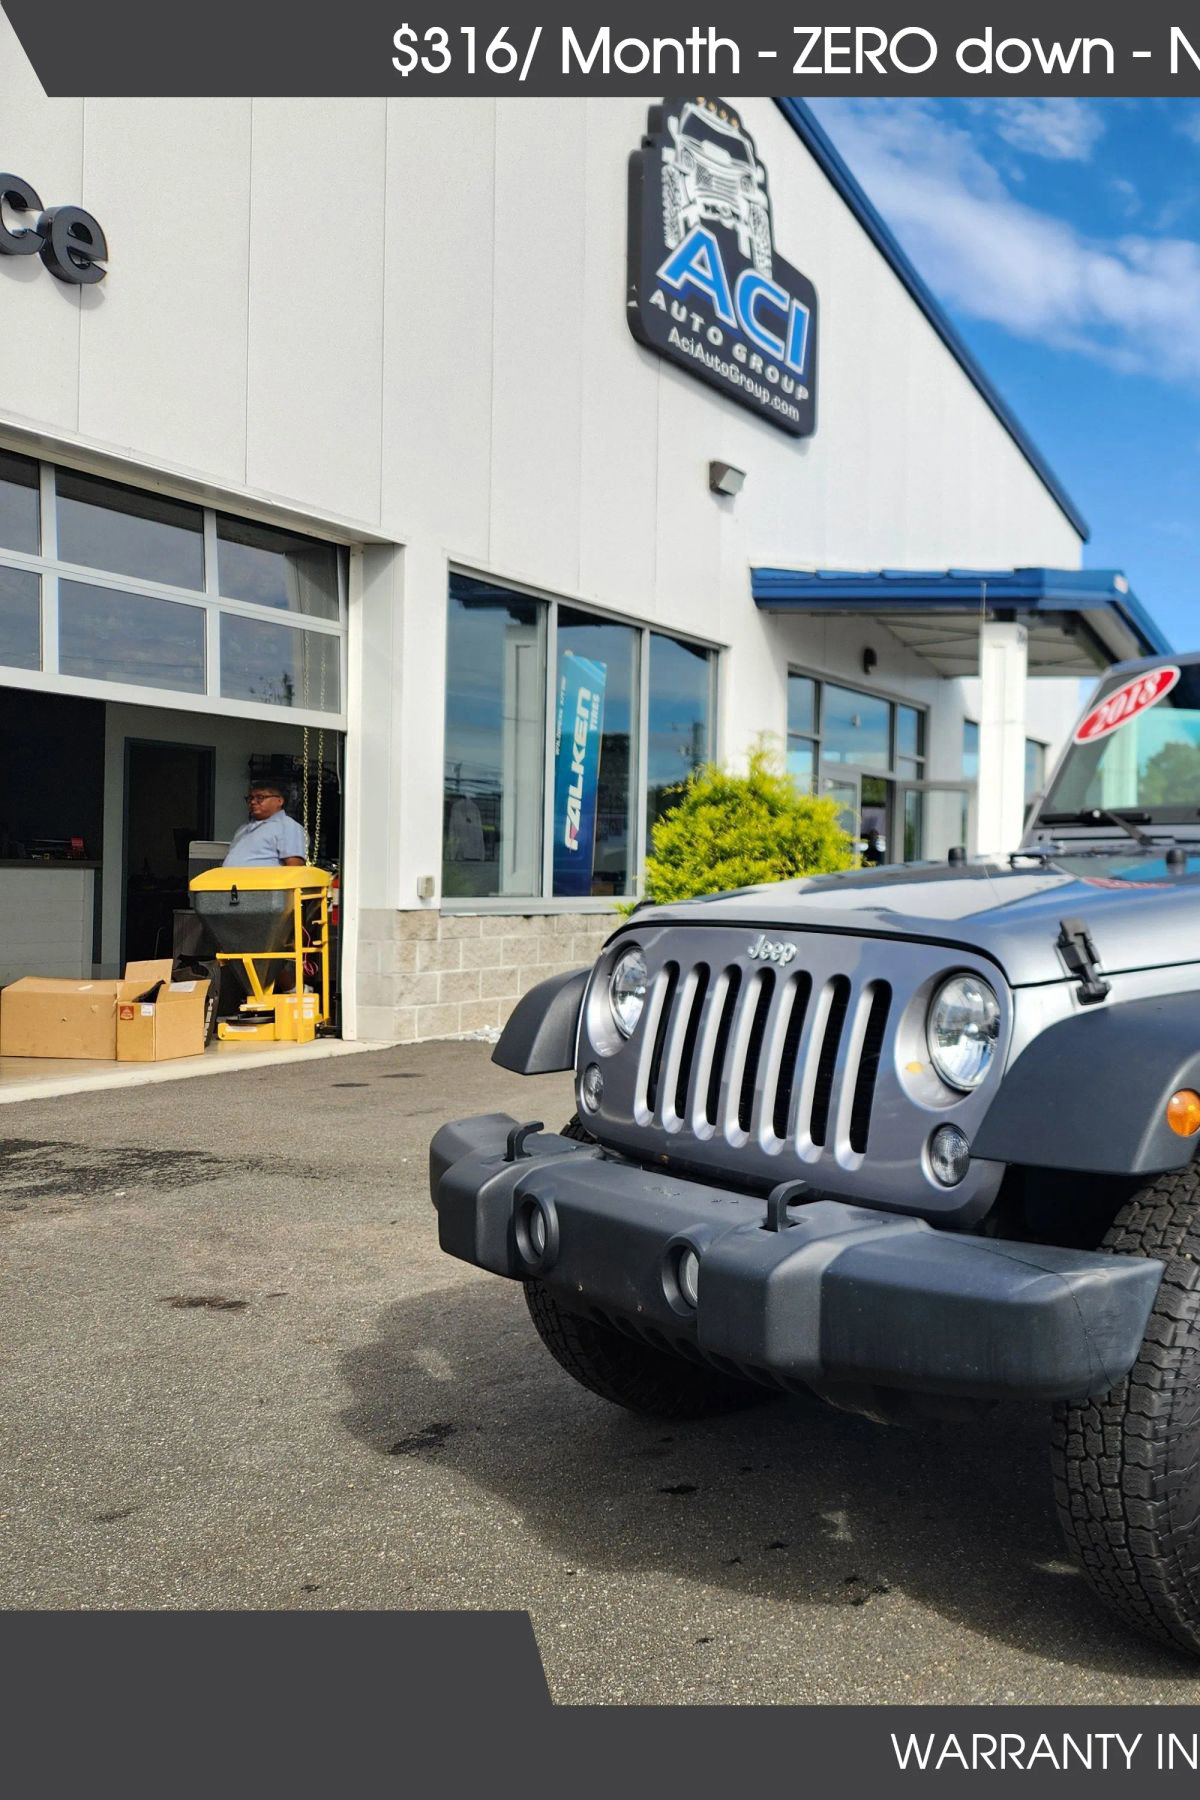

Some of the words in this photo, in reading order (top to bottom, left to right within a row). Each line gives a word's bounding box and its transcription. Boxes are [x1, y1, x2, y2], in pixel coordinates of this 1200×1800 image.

[648, 288, 725, 347] AUTO
[732, 342, 809, 401] GROUP
[656, 223, 810, 376] ACI
[667, 325, 801, 422] AciAutoGroup.com
[1086, 672, 1163, 737] 2018
[746, 934, 798, 967] Jeep
